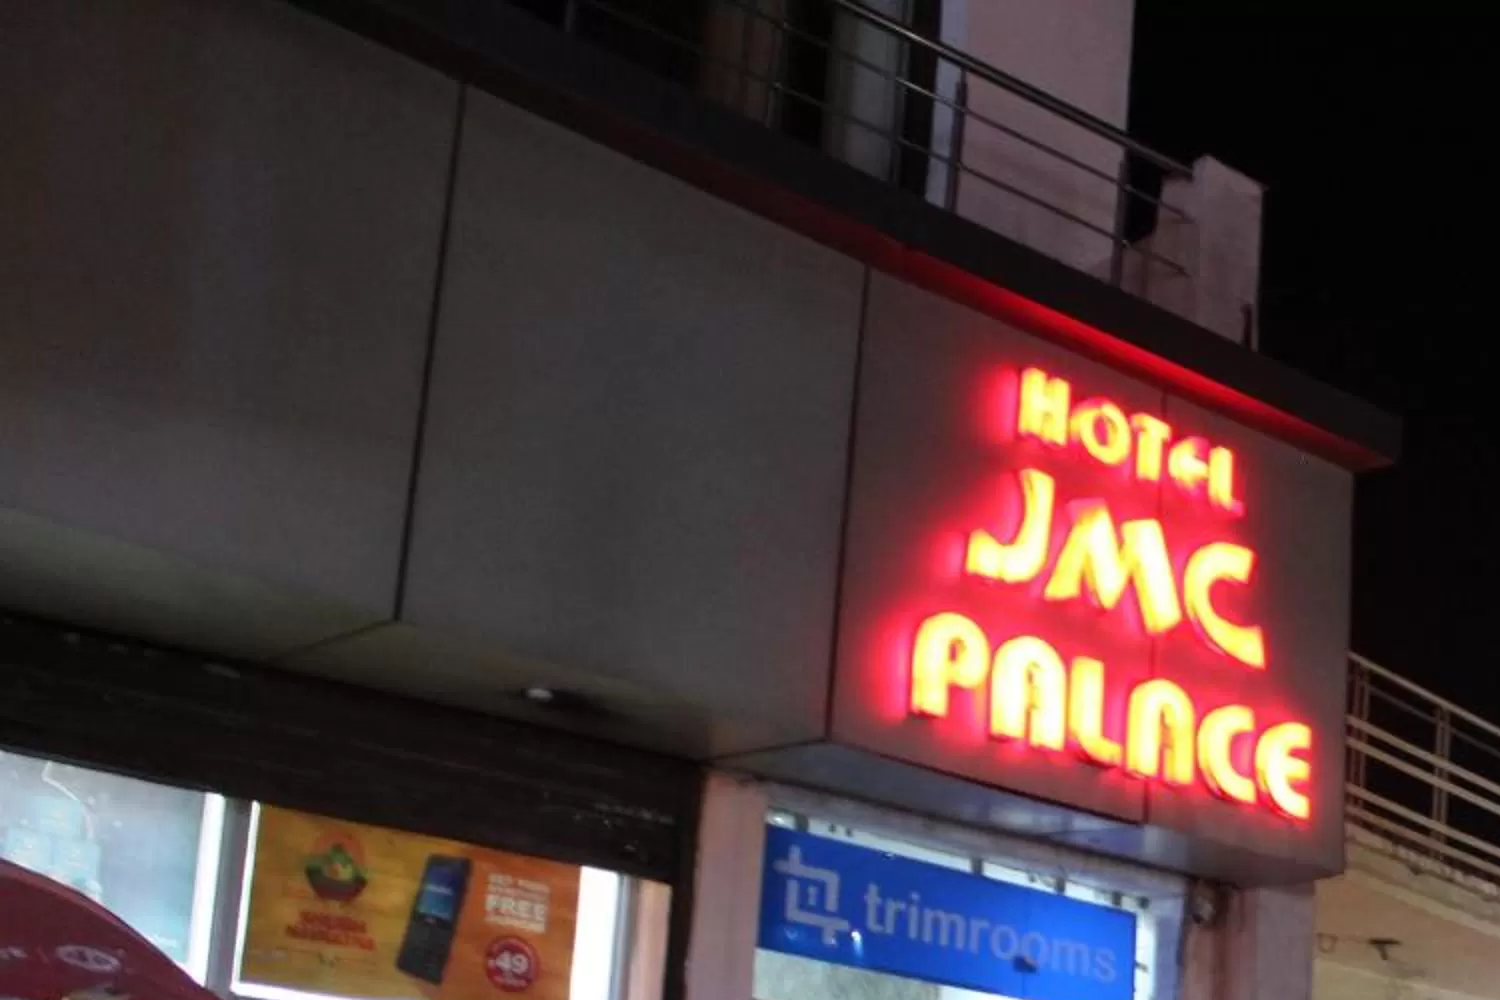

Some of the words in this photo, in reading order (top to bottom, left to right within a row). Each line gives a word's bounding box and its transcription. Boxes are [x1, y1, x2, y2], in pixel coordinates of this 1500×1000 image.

[1018, 367, 1236, 511] HOTEL
[965, 468, 1266, 669] JMC
[911, 612, 1312, 820] PALACE
[863, 883, 1118, 983] trimrooms
